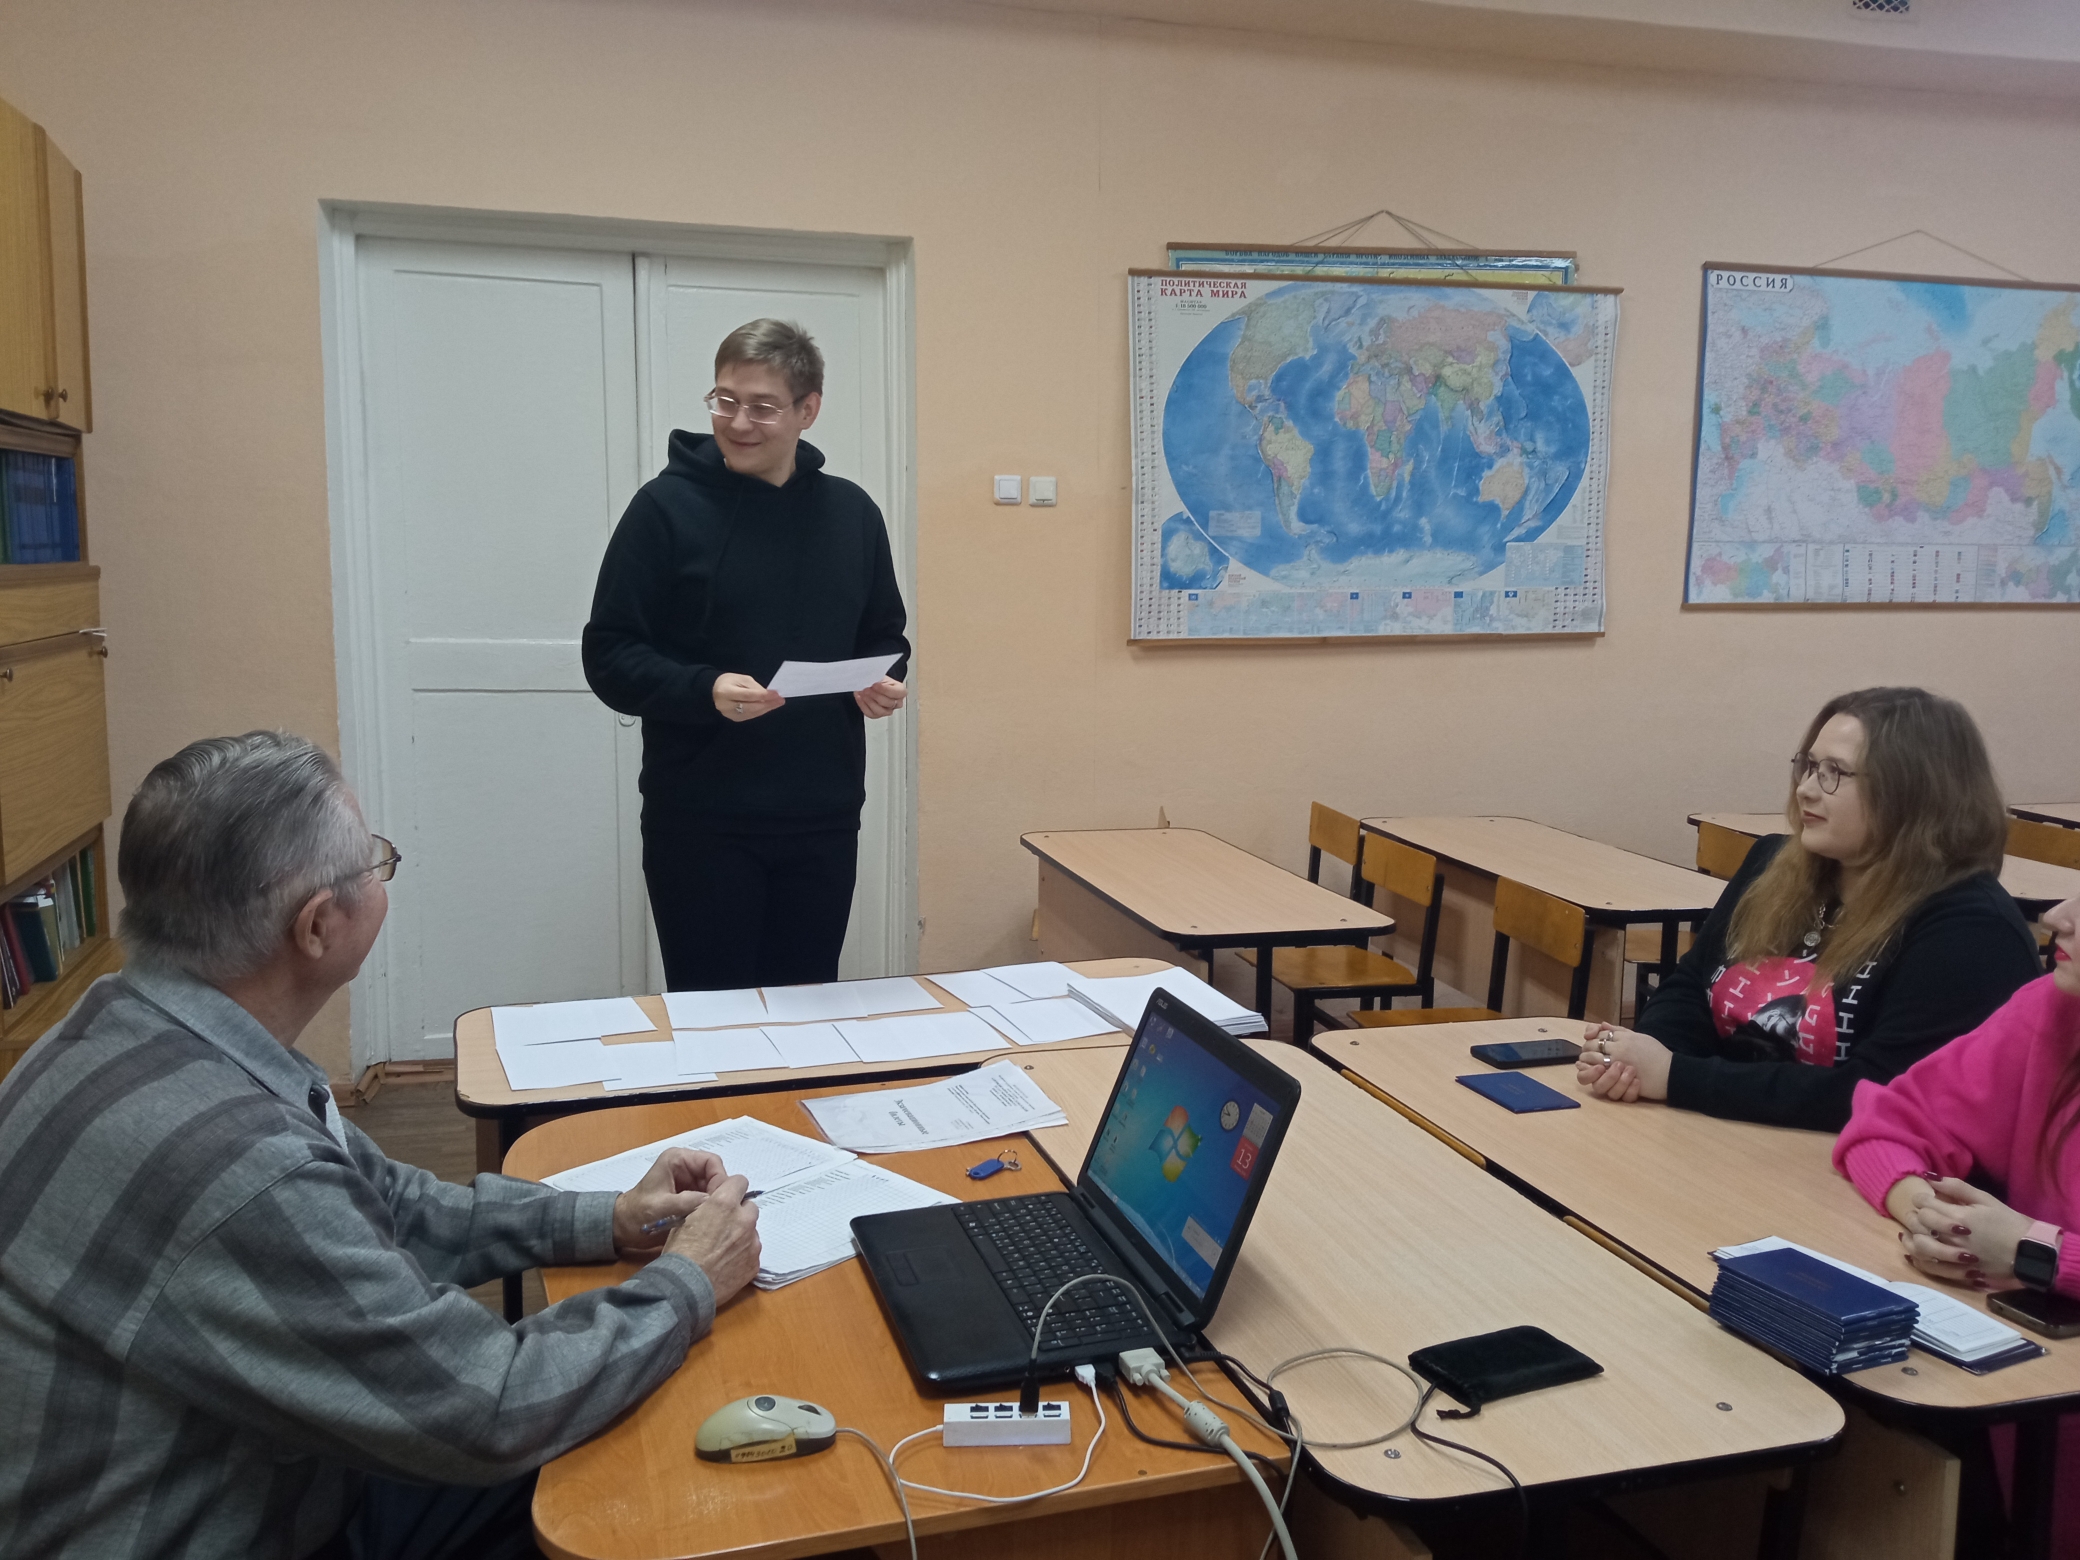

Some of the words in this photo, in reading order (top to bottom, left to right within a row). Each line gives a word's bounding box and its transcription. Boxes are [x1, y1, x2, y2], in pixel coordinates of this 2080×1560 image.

[1160, 279, 1247, 289] ПОЛИТИЧЕСКАЯ
[1715, 273, 1788, 290] РОССИЯ
[1160, 288, 1203, 298] КАРТА
[1210, 289, 1247, 299] МИРА
[1237, 1149, 1252, 1169] 13
